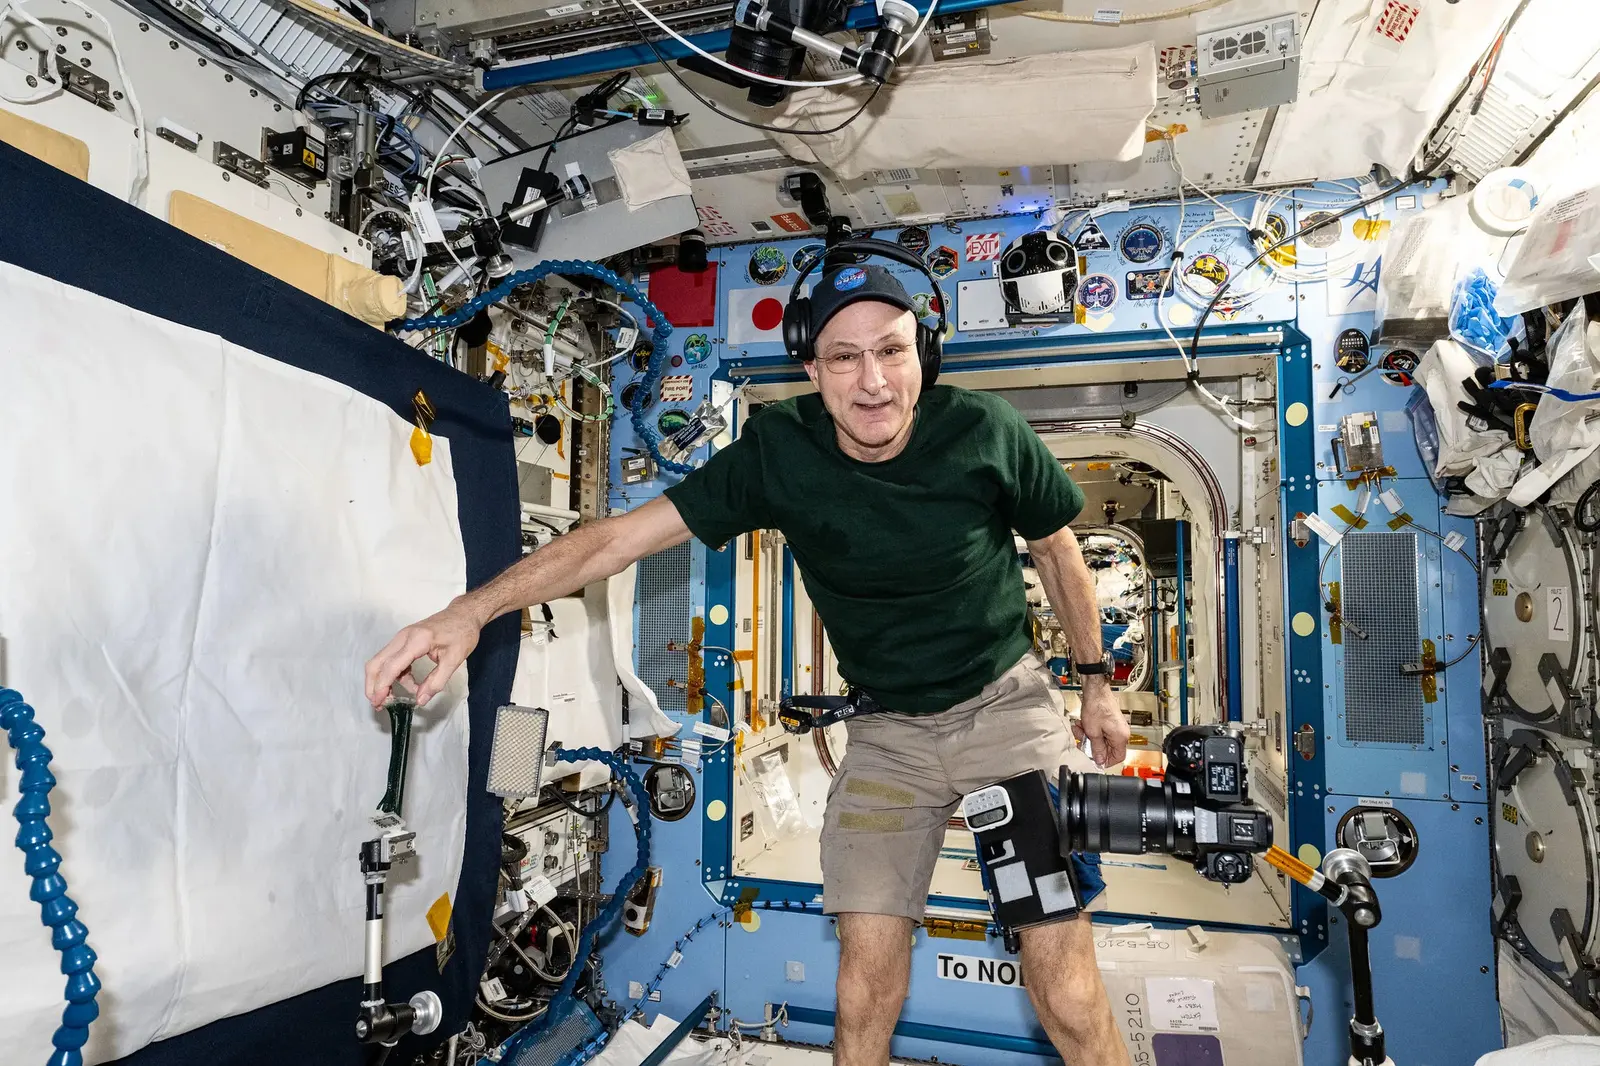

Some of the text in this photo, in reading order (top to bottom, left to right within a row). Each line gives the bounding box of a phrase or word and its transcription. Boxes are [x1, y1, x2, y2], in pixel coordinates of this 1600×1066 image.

[971, 240, 994, 255] EXIT
[836, 273, 864, 286] NASA
[1552, 596, 1564, 631] 2
[938, 955, 968, 979] To
